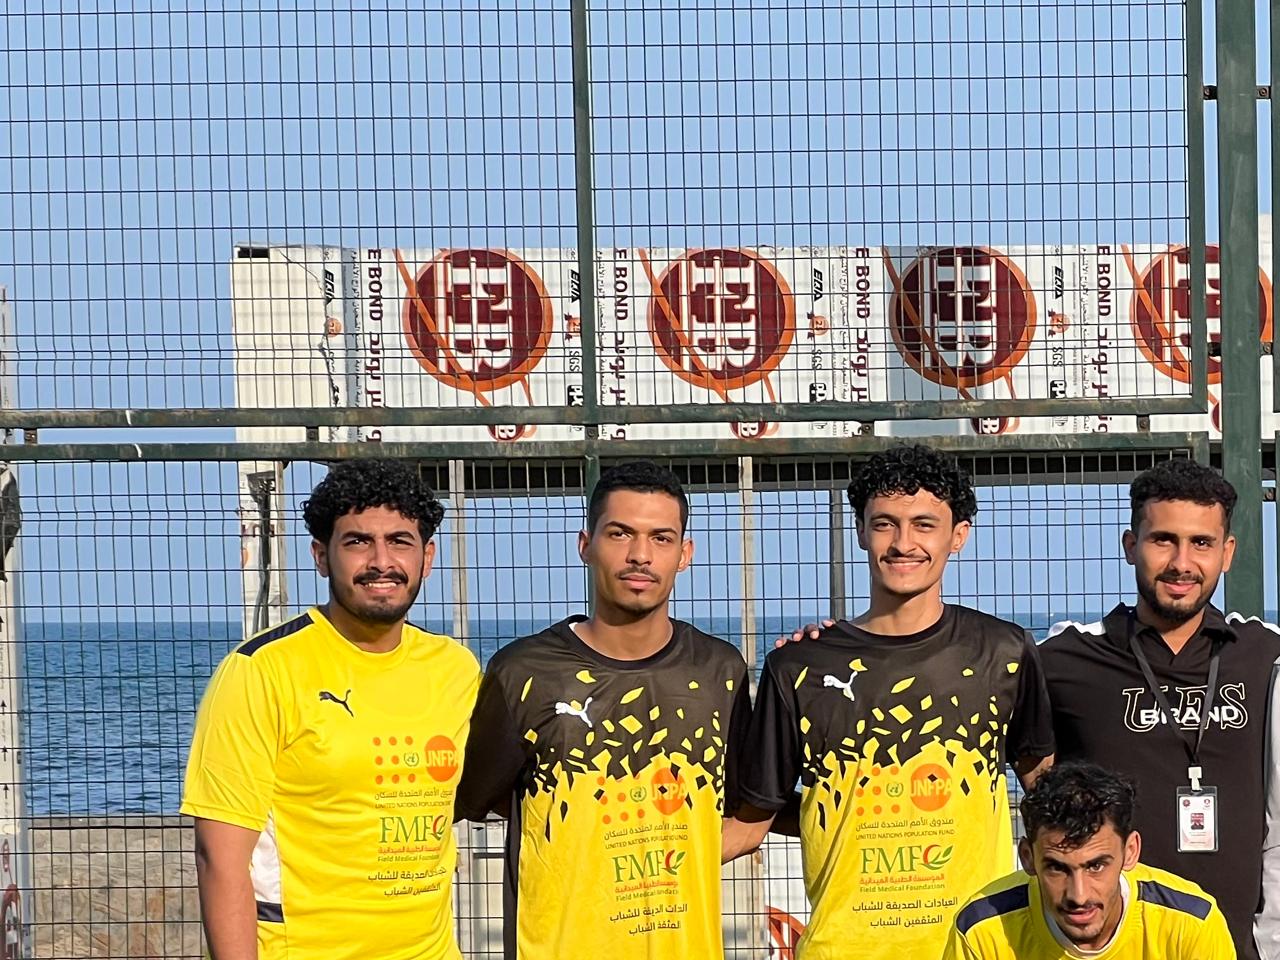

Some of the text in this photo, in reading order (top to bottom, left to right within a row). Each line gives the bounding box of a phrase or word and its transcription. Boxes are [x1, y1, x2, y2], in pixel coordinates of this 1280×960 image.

[368, 267, 383, 321] BOND
[614, 267, 628, 320] BOND
[856, 265, 870, 319] BOND
[1097, 263, 1111, 317] BOND
[855, 817, 953, 832] صندوق الأمم المتحدة للسكان
[906, 883, 945, 891] Foundation
[852, 897, 958, 913] العيادات الصديقة للشباب
[870, 915, 943, 928] المثقفين الشباب
